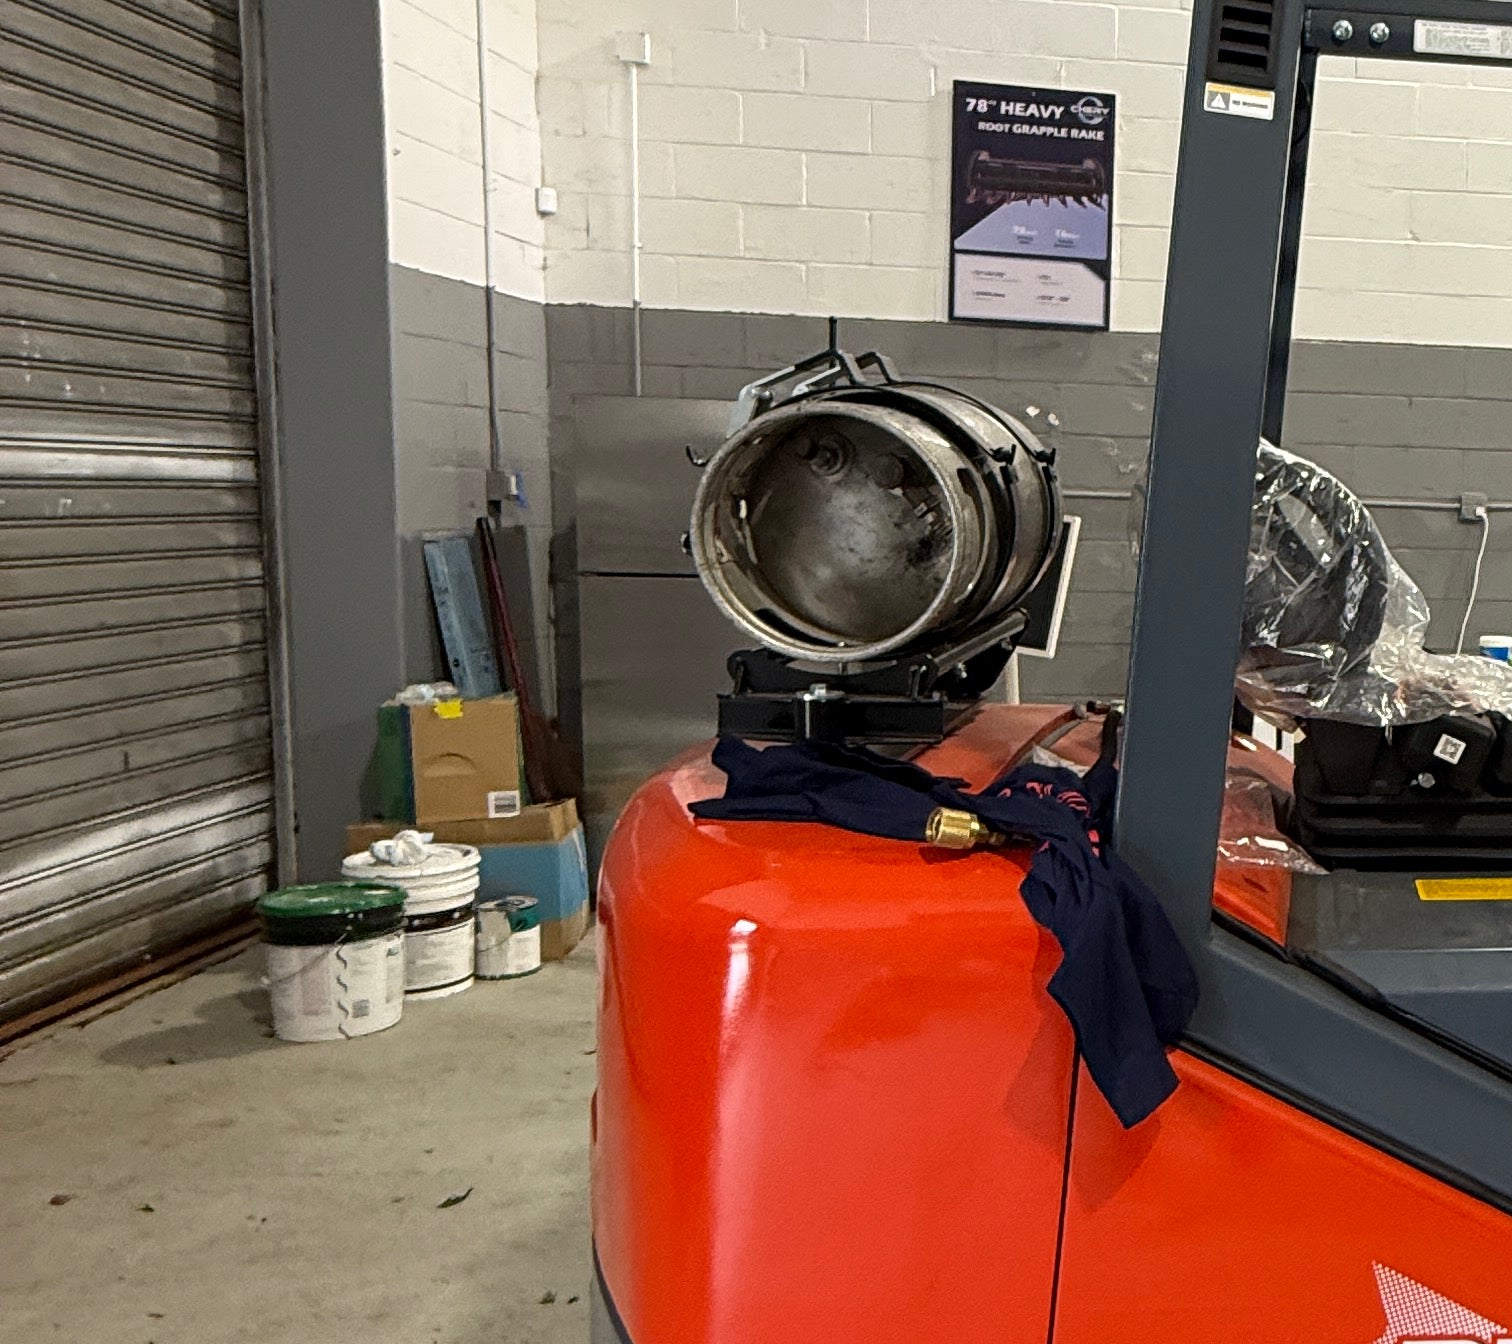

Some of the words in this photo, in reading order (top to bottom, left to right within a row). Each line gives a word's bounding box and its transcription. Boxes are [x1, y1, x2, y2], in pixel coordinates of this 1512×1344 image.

[1000, 101, 1064, 119] HEAVY
[978, 121, 1010, 133] ROOT
[1012, 123, 1068, 138] GRAPPLE
[1070, 128, 1105, 141] RAKE
